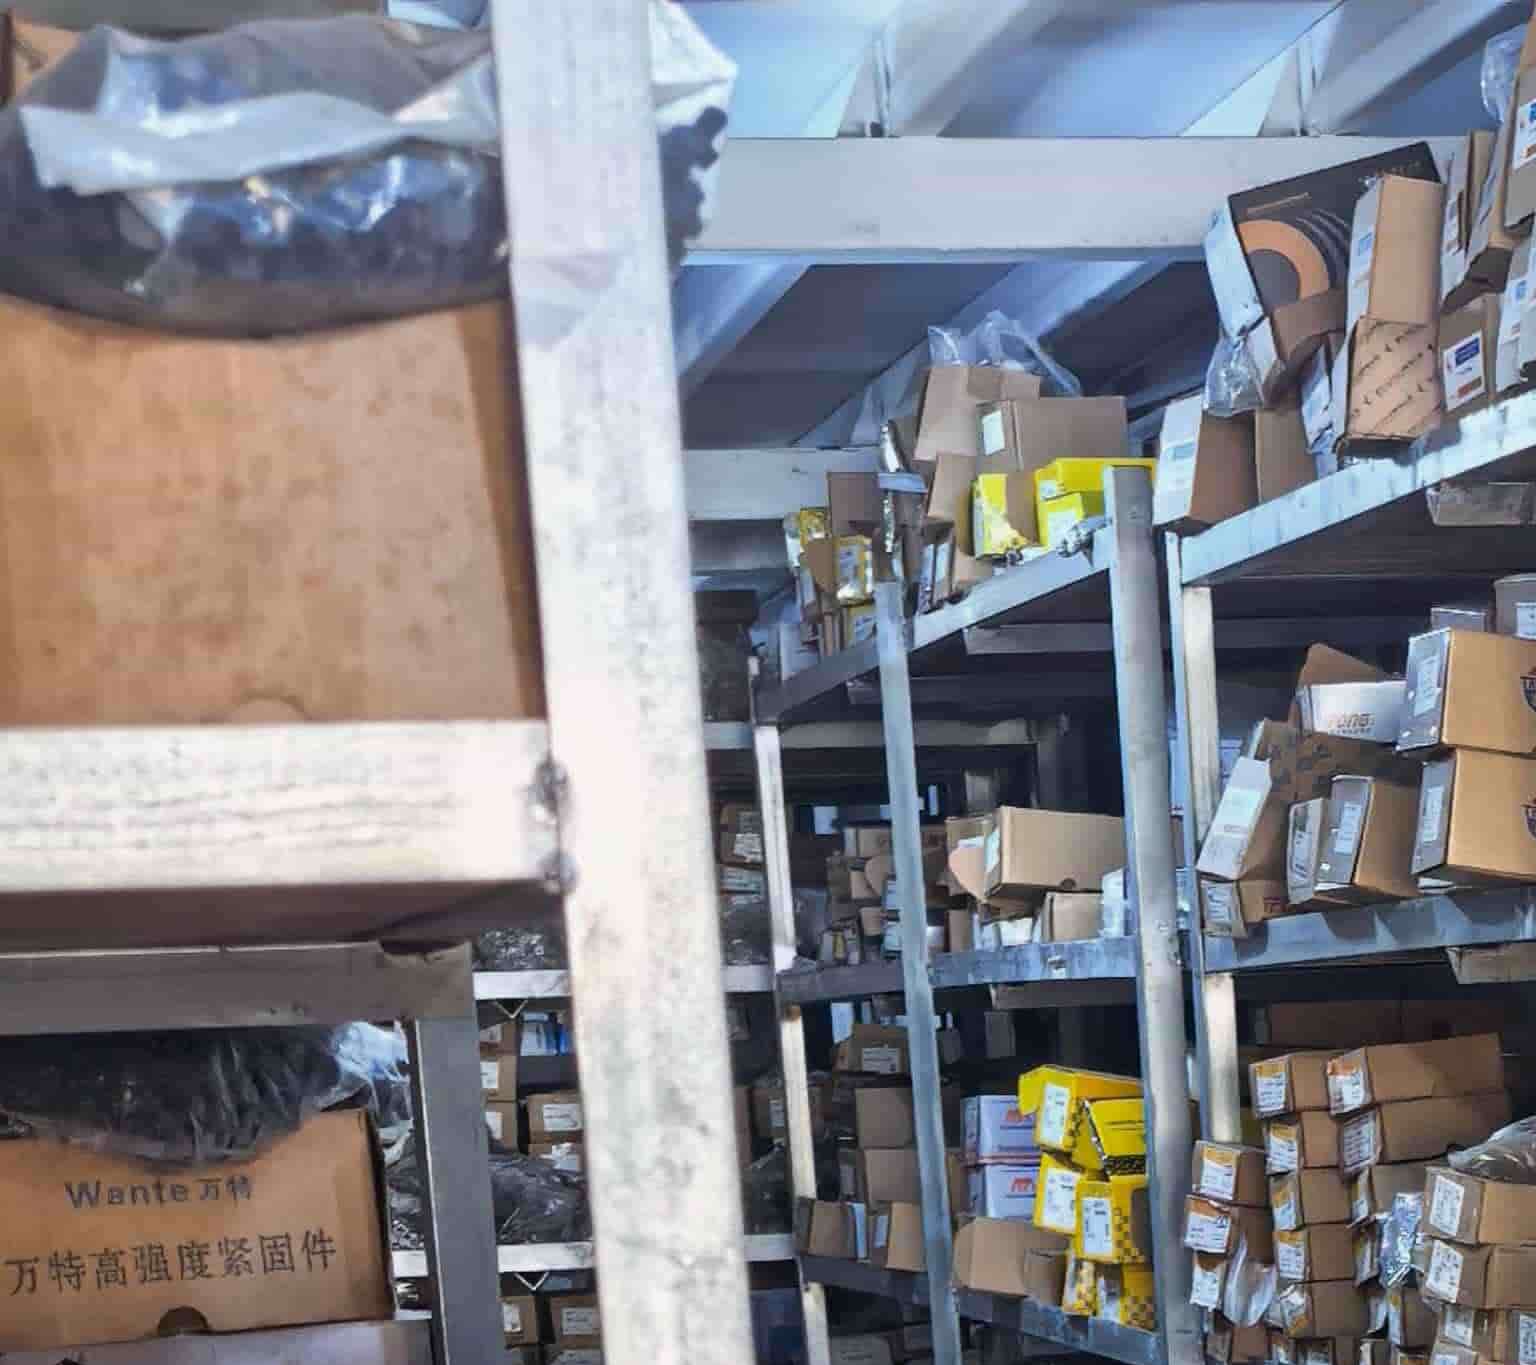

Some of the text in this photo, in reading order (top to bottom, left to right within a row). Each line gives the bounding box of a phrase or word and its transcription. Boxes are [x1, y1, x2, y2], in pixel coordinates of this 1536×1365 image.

[65, 1172, 253, 1209] Wante 万特
[4, 1227, 338, 1297] 万特高强度紧固件
